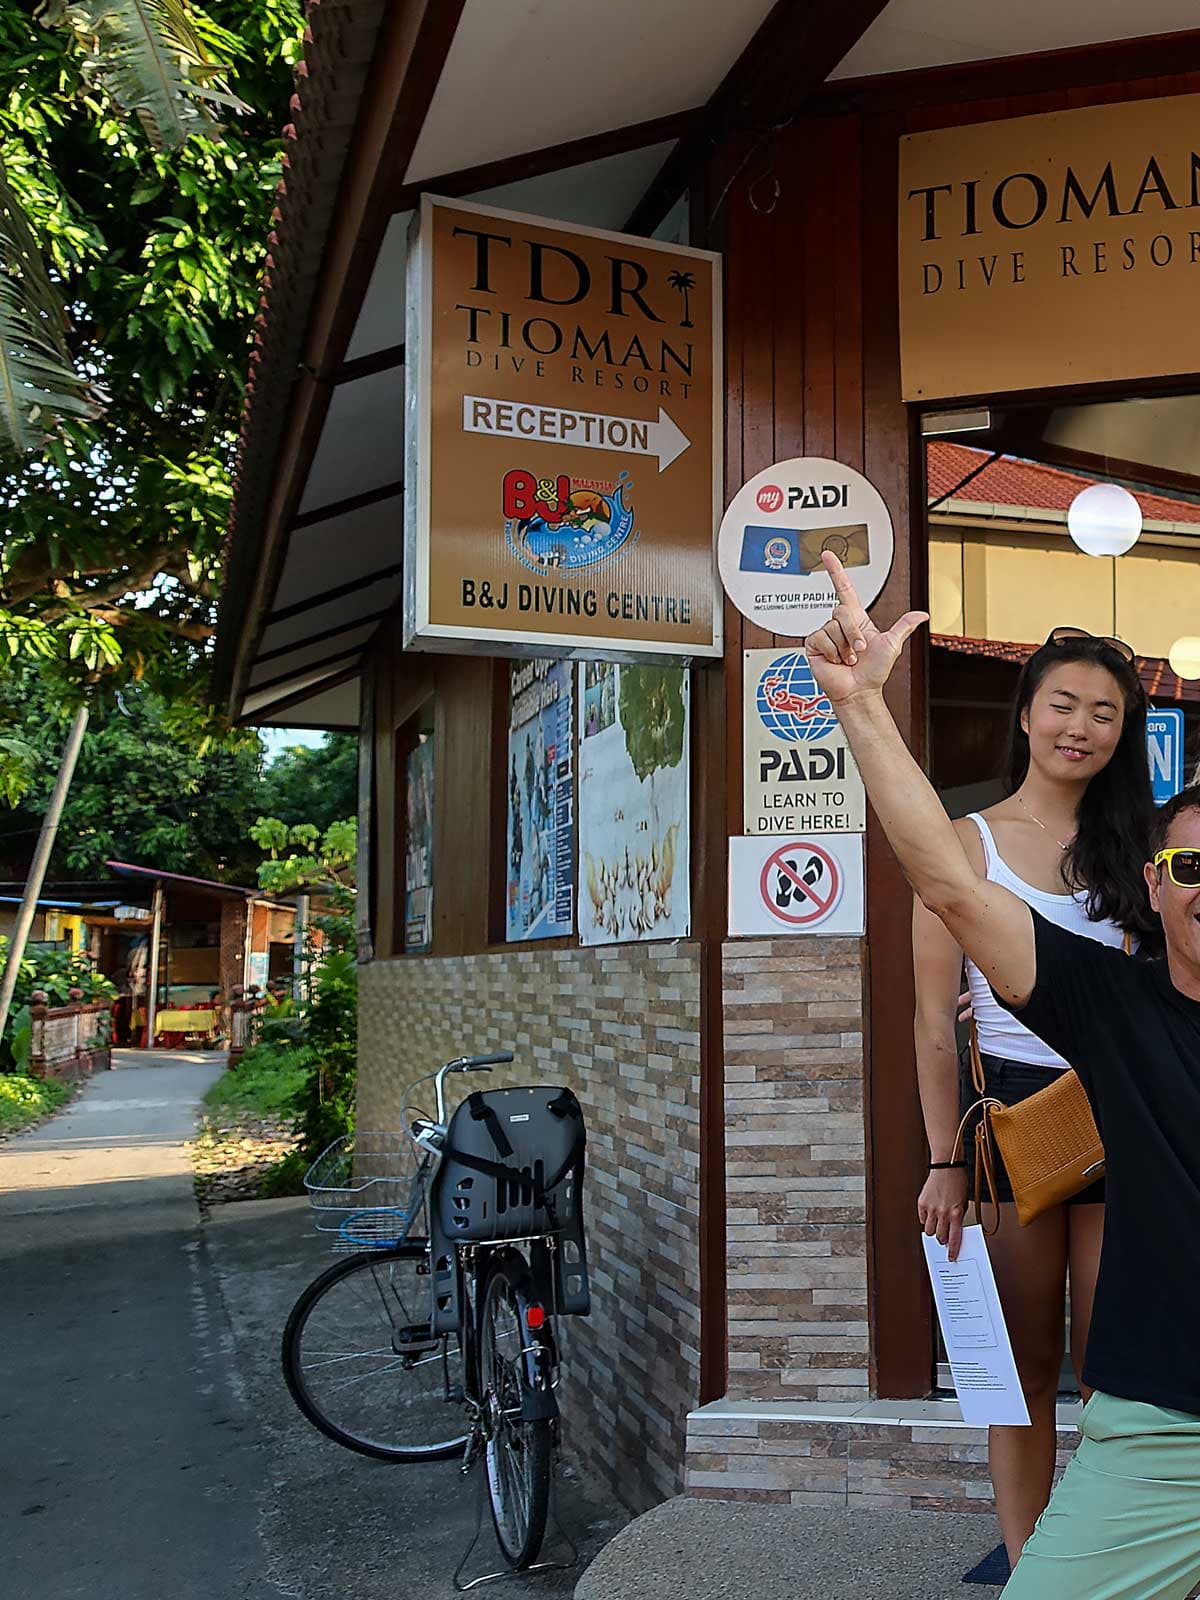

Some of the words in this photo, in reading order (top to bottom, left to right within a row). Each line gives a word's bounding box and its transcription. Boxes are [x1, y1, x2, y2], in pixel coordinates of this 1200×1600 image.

[452, 228, 665, 323] TDR
[922, 252, 1025, 295] DIVE
[456, 305, 692, 376] TIOMAN
[467, 350, 545, 377] DIVE
[572, 366, 691, 398] RESORT
[473, 401, 648, 449] RECEPTION
[503, 470, 570, 523] B&J
[758, 491, 780, 508] my
[788, 485, 850, 509] PADI
[570, 547, 604, 563] DIVING
[607, 515, 629, 547] CENTRE
[462, 580, 508, 609] B&J
[519, 585, 597, 616] DIVING
[606, 592, 692, 625] CENTRE
[755, 595, 772, 603] GET
[775, 593, 801, 602] YOUR
[803, 592, 824, 601] PADI
[760, 747, 846, 782] PADI
[759, 815, 794, 831] DIVE
[801, 814, 850, 830] HERE!
[763, 792, 816, 809] LEARN
[823, 792, 844, 806] TO
